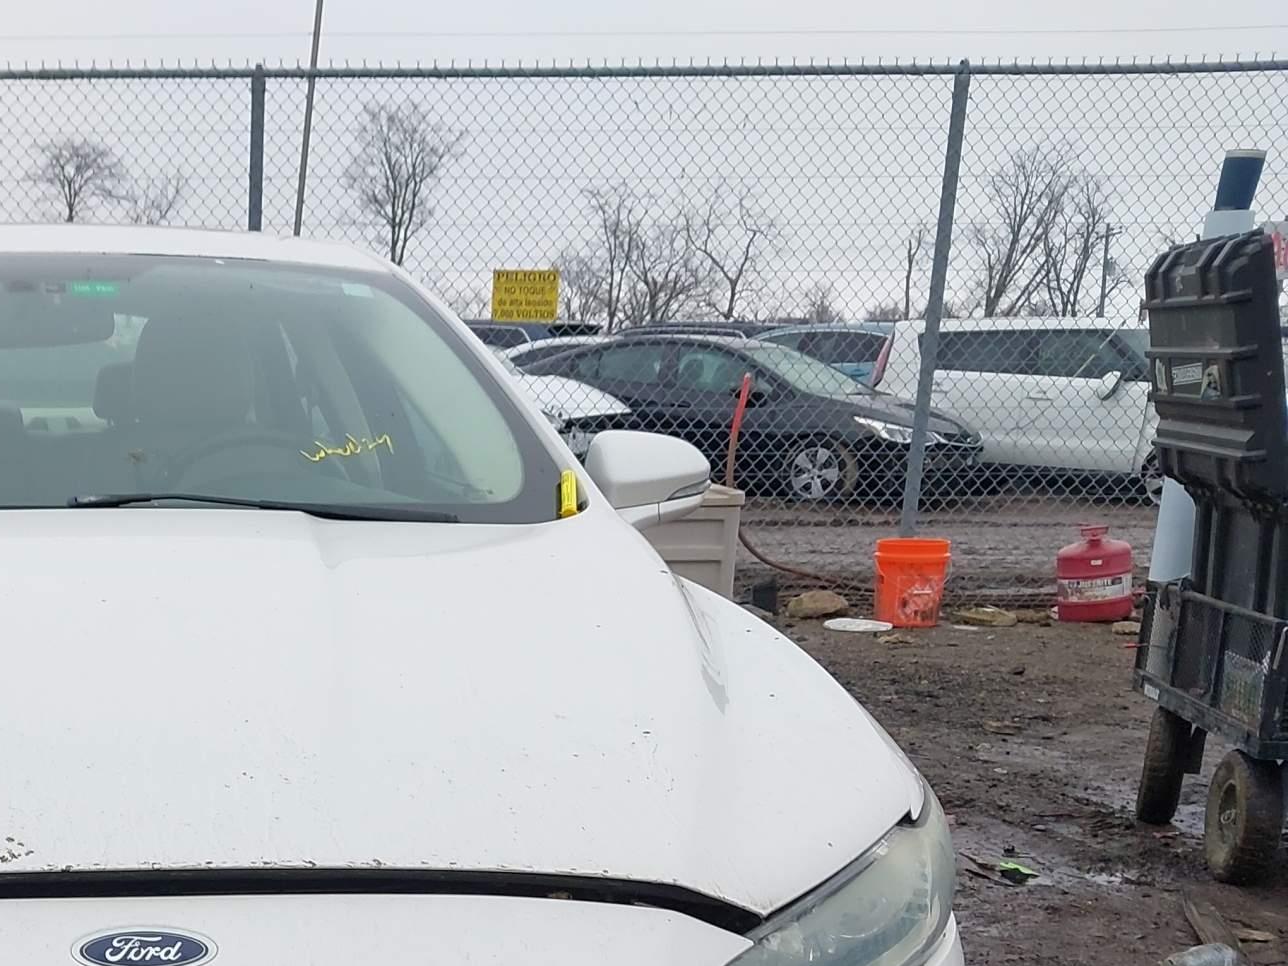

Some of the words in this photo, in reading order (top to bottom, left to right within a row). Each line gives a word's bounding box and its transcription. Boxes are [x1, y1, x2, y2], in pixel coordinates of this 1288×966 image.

[497, 271, 557, 282] PELIGRO
[504, 286, 516, 295] NO
[519, 286, 546, 295] TOQUE
[516, 309, 555, 318] VOLTIOS
[105, 935, 182, 962] Ford
